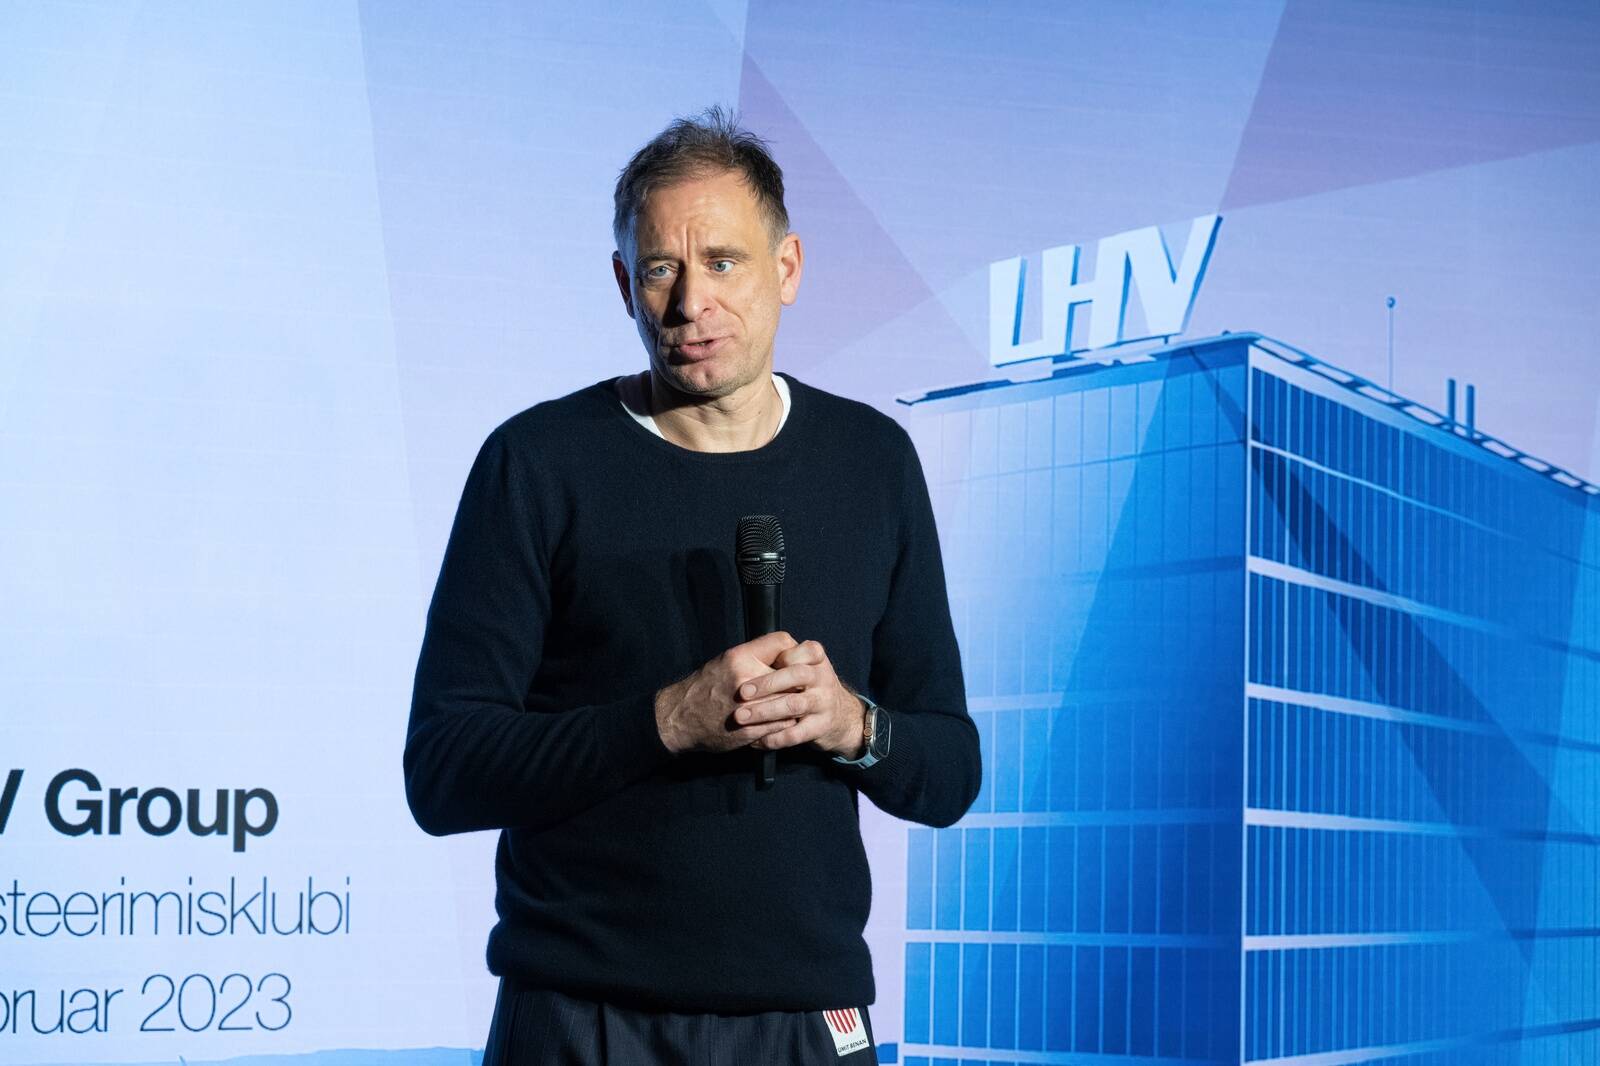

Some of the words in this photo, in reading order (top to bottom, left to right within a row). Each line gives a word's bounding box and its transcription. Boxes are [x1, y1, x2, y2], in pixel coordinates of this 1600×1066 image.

[990, 213, 1222, 367] LHV
[44, 768, 279, 852] Group
[0, 876, 350, 937] teerimisklubi
[0, 988, 124, 1034] ruar
[140, 972, 292, 1032] 2023
